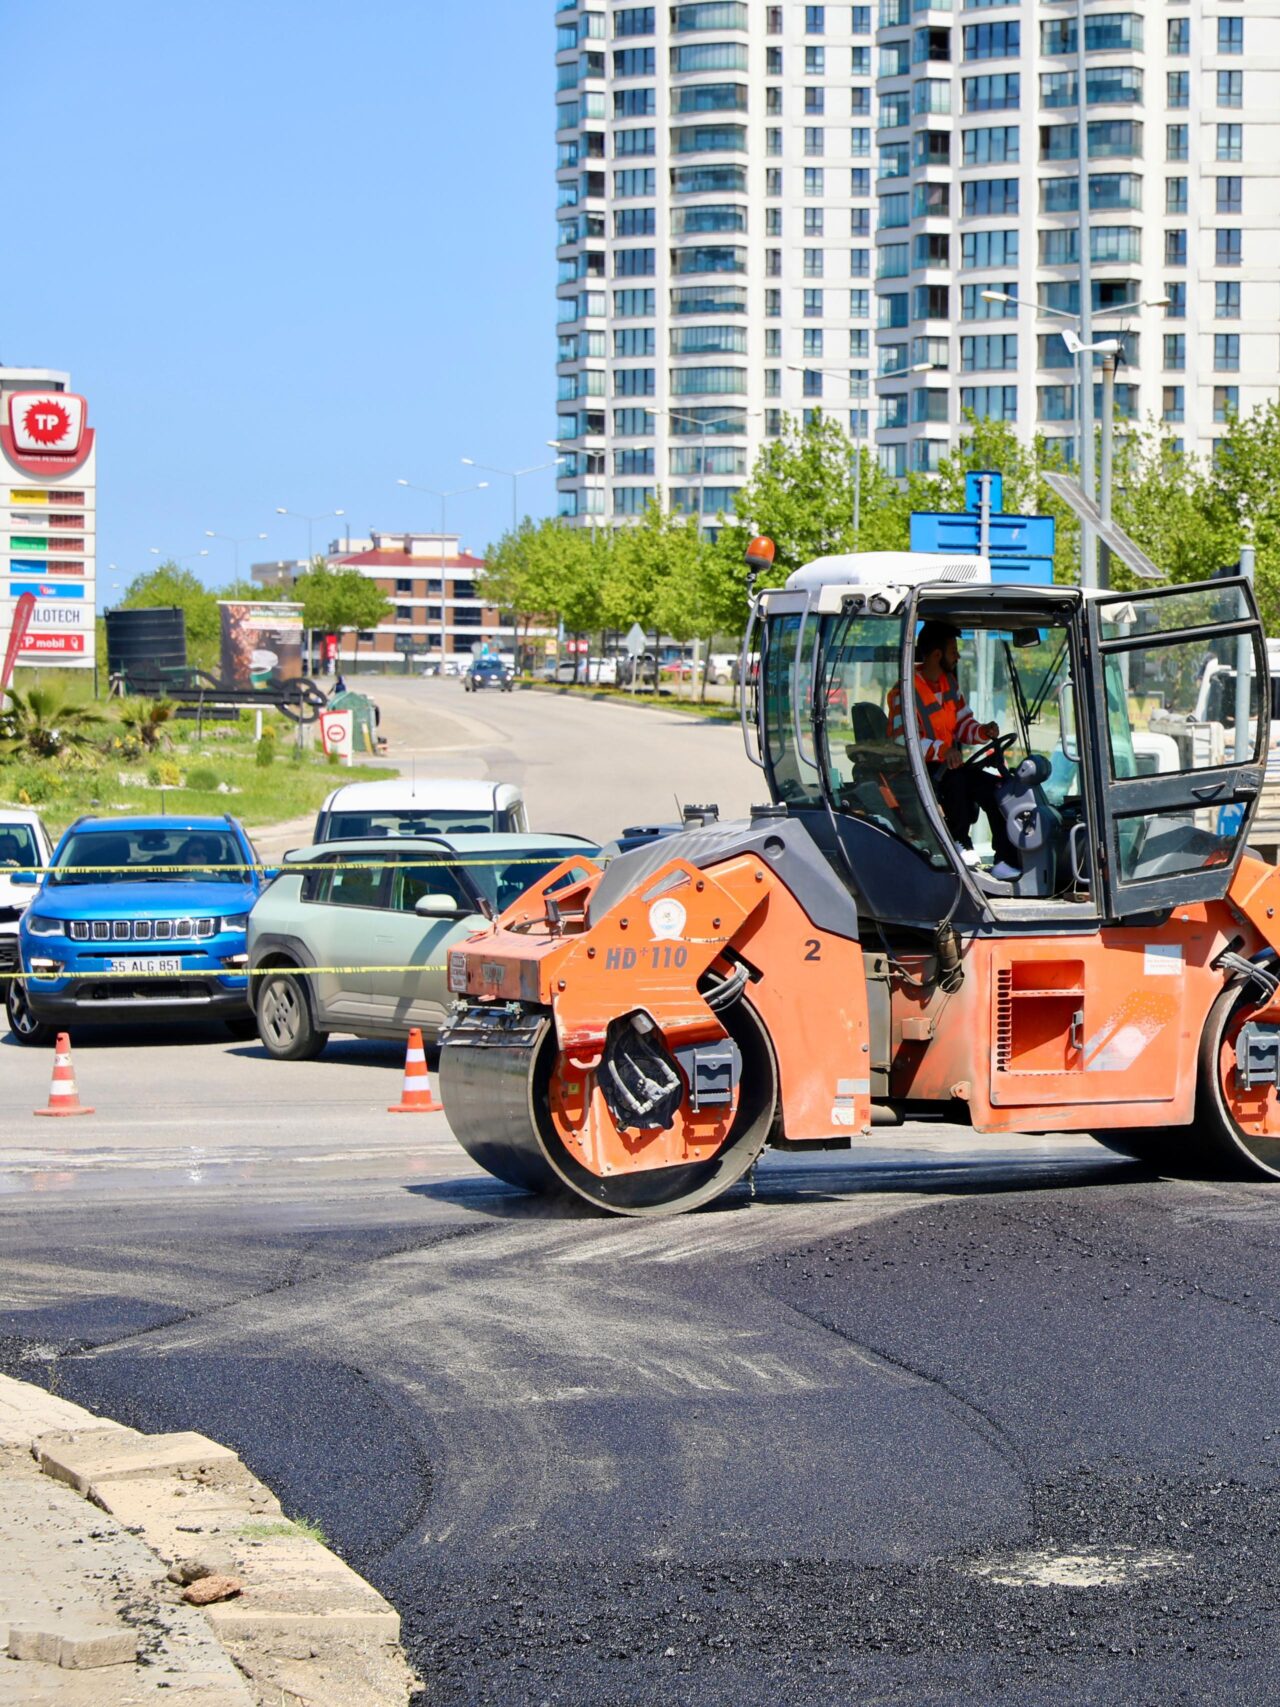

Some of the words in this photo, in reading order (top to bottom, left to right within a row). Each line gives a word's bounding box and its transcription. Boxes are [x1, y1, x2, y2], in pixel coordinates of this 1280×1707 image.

[35, 413, 60, 431] TP
[33, 607, 81, 623] ILOTECH
[36, 637, 65, 649] mobil
[651, 945, 689, 969] 110
[804, 938, 821, 961] 2
[111, 961, 126, 972] 55
[132, 960, 154, 972] ALG
[160, 960, 179, 971] 851
